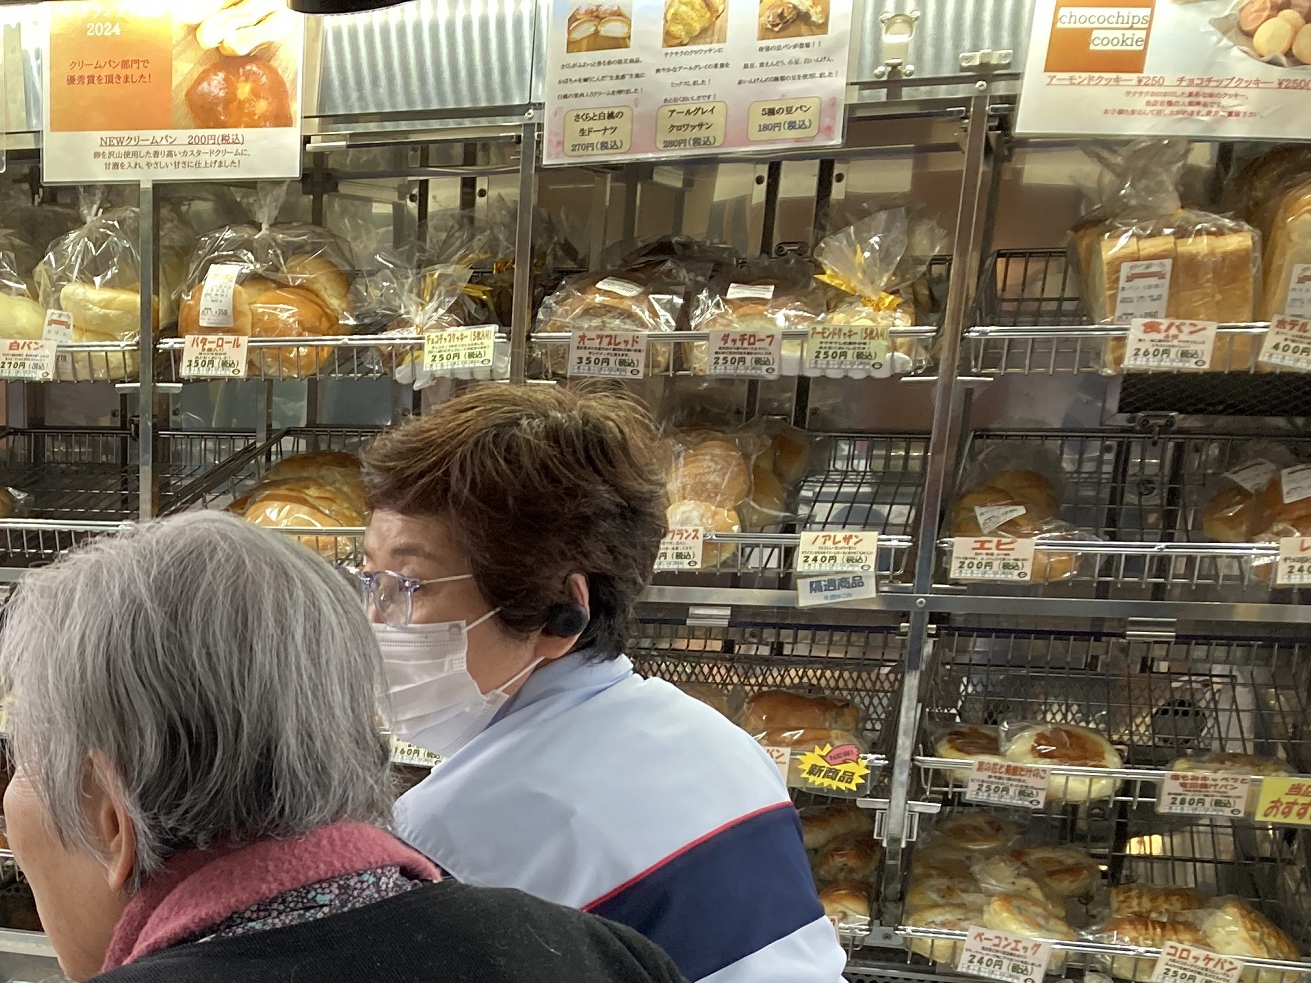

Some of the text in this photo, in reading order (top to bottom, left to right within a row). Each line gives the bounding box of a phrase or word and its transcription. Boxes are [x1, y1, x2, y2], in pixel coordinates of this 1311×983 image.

[1059, 10, 1149, 30] chocochips
[86, 22, 121, 37] 2024
[1091, 33, 1145, 48] cookie
[69, 59, 150, 71] クリームパン部門で
[66, 74, 152, 86] 優秀賞を頂きました！
[1046, 75, 1134, 86] アーモンドクッキー
[1136, 76, 1165, 87] ¥250
[1175, 76, 1274, 88] チョコチップクッキー
[574, 111, 624, 122] さくらと白桃の
[667, 105, 716, 118] アールグレイ
[761, 105, 811, 117] 5種の豆パン
[578, 126, 618, 137] 生ドーナツ
[668, 122, 713, 133] クロワッサン
[758, 119, 812, 132] 180円(税込)
[99, 134, 245, 147] NEWクリームパン 200円(税込)
[571, 140, 623, 152] 270円(税込)
[663, 136, 717, 149] 280円(税込)
[1142, 321, 1207, 335] 食パン
[9, 340, 44, 351] 白パン
[191, 337, 241, 349] バターロール
[721, 333, 775, 346] ダッチローフ
[431, 351, 486, 362] 250円（税込）
[577, 357, 639, 367] 350円（税込）
[187, 360, 239, 369] 350円（税込）
[670, 529, 699, 540] フランス
[812, 535, 863, 545] ノアレザン
[971, 539, 1017, 551] エピ
[810, 576, 864, 593] 隔週商品
[829, 750, 855, 760] NEW!
[806, 764, 856, 784] 新商品
[1166, 945, 1238, 973] コロッケパン
